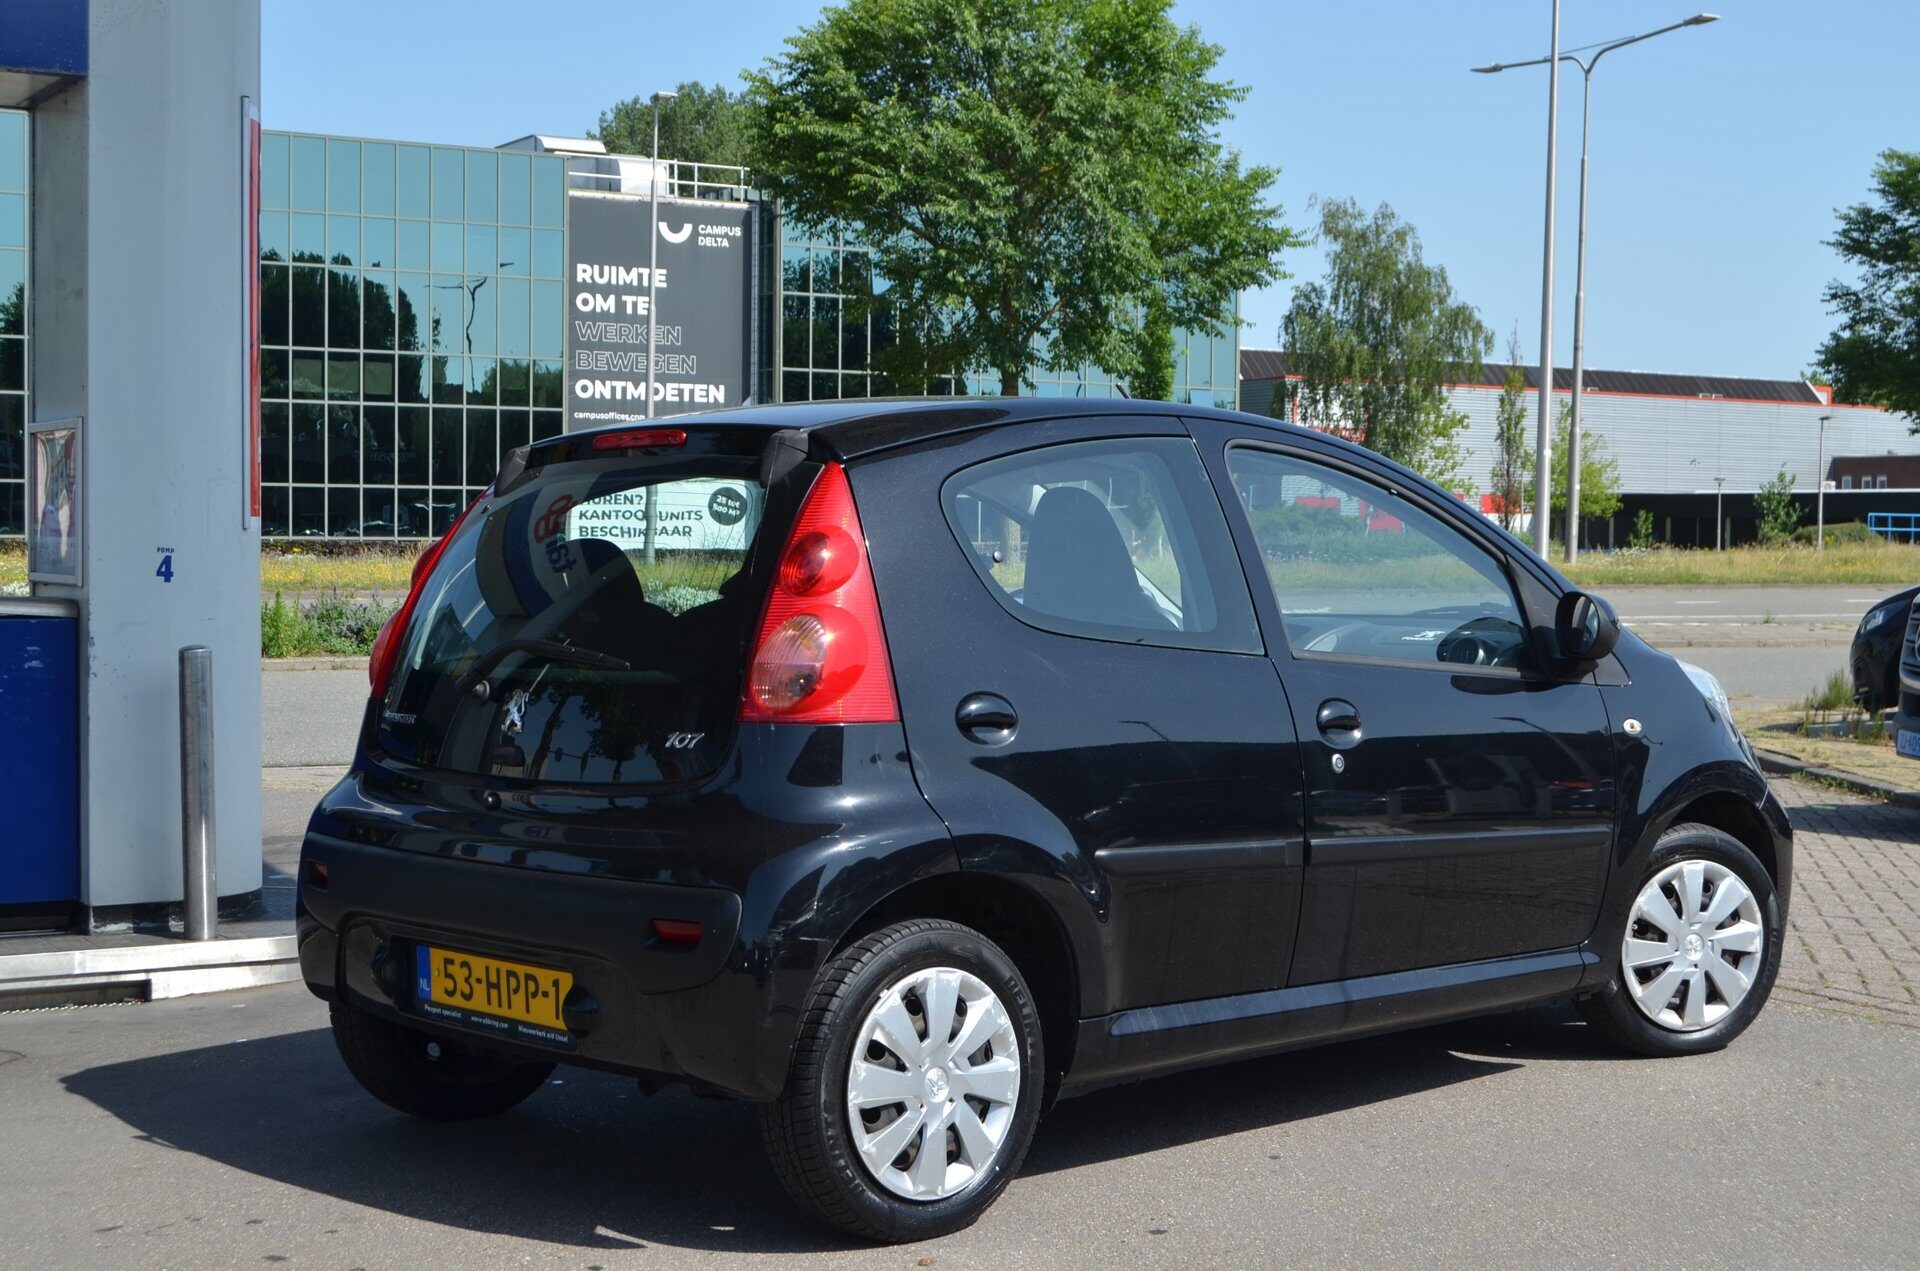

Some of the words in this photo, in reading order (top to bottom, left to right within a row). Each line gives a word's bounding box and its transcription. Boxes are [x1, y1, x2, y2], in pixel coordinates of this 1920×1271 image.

[698, 224, 741, 236] CAMPUS
[698, 236, 729, 248] DELTA
[576, 263, 668, 288] RUIMTE
[575, 292, 615, 314] OM
[622, 295, 650, 315] TE
[575, 321, 682, 346] WERKEN
[575, 350, 697, 375] BEWEGEN
[574, 379, 725, 404] ONTMOETEN
[583, 493, 643, 505] UREN?
[579, 509, 703, 521] KANTOOUNITS
[579, 525, 692, 538] BESCHIKAAR
[156, 555, 174, 583] 4
[664, 731, 705, 749] 107
[419, 978, 430, 991] NL
[443, 957, 560, 1021] 53-HPP-1
